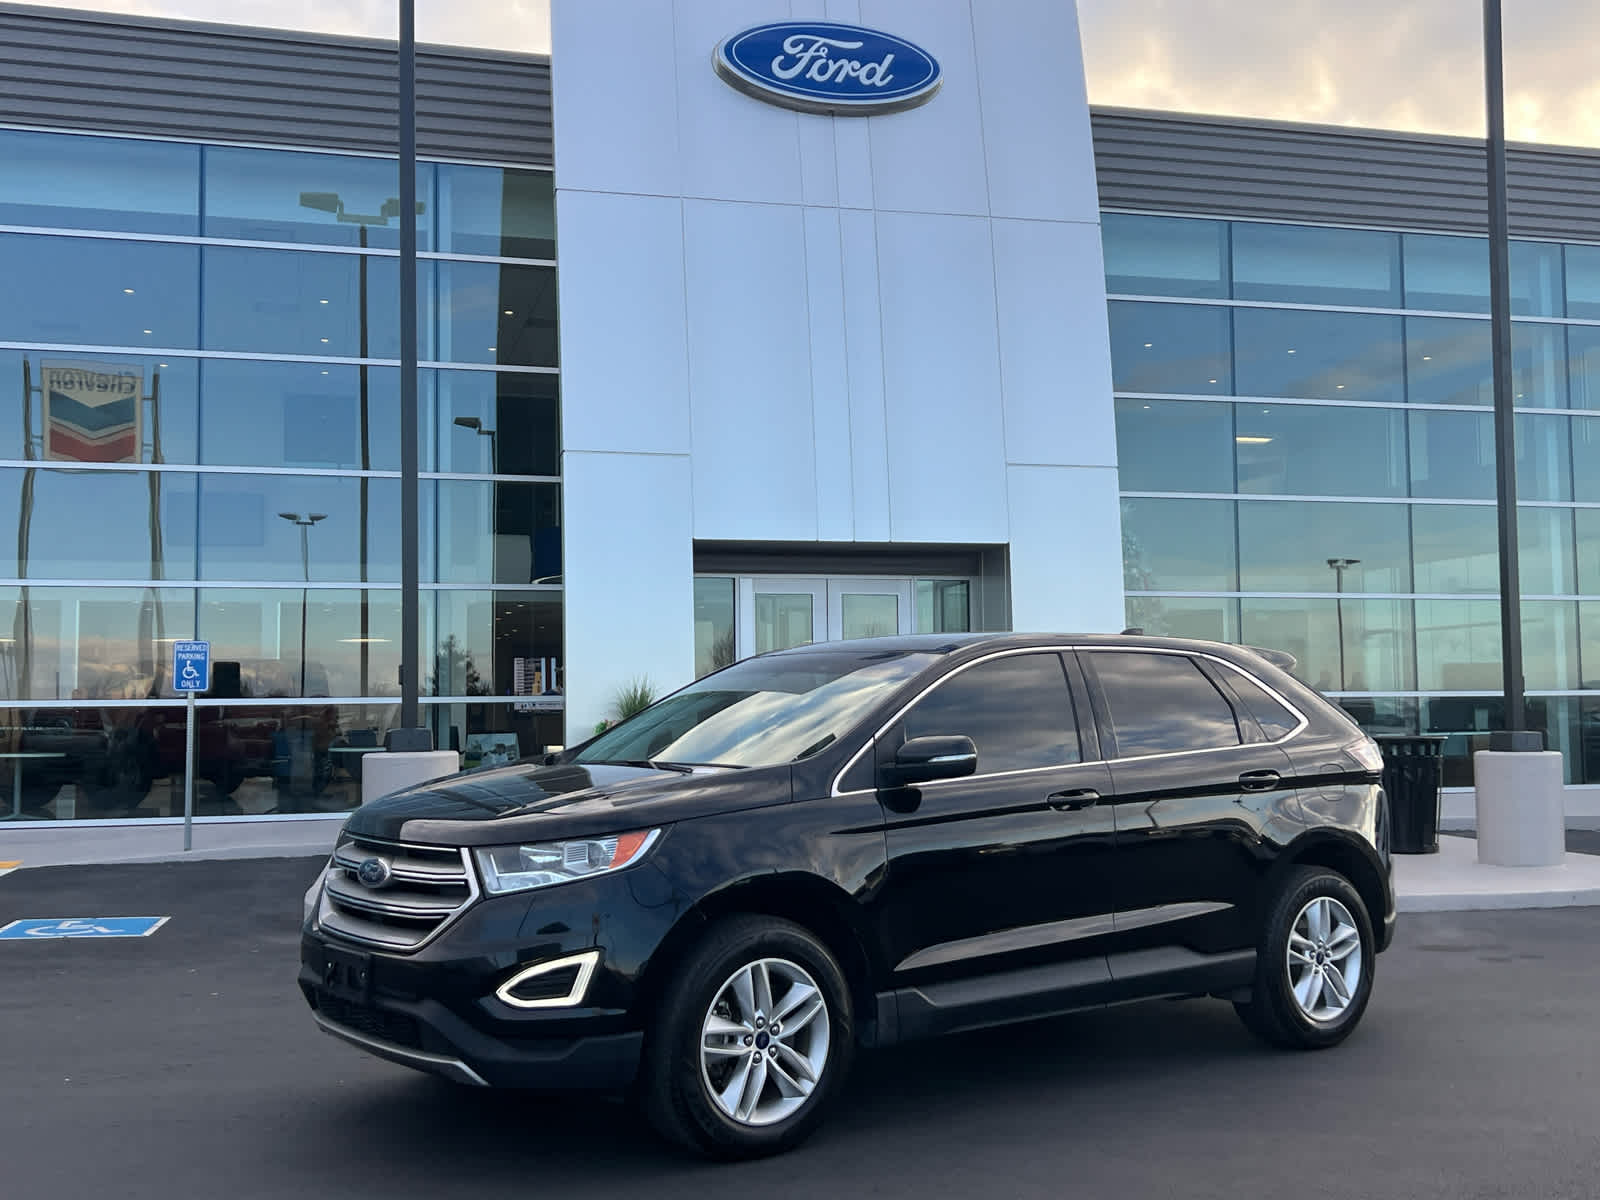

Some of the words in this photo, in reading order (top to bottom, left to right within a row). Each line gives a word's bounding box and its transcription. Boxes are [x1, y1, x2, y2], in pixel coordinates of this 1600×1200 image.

[771, 34, 895, 87] Ford
[176, 643, 208, 651] RESERVED
[178, 652, 205, 660] PARKING
[181, 680, 200, 689] ONLY
